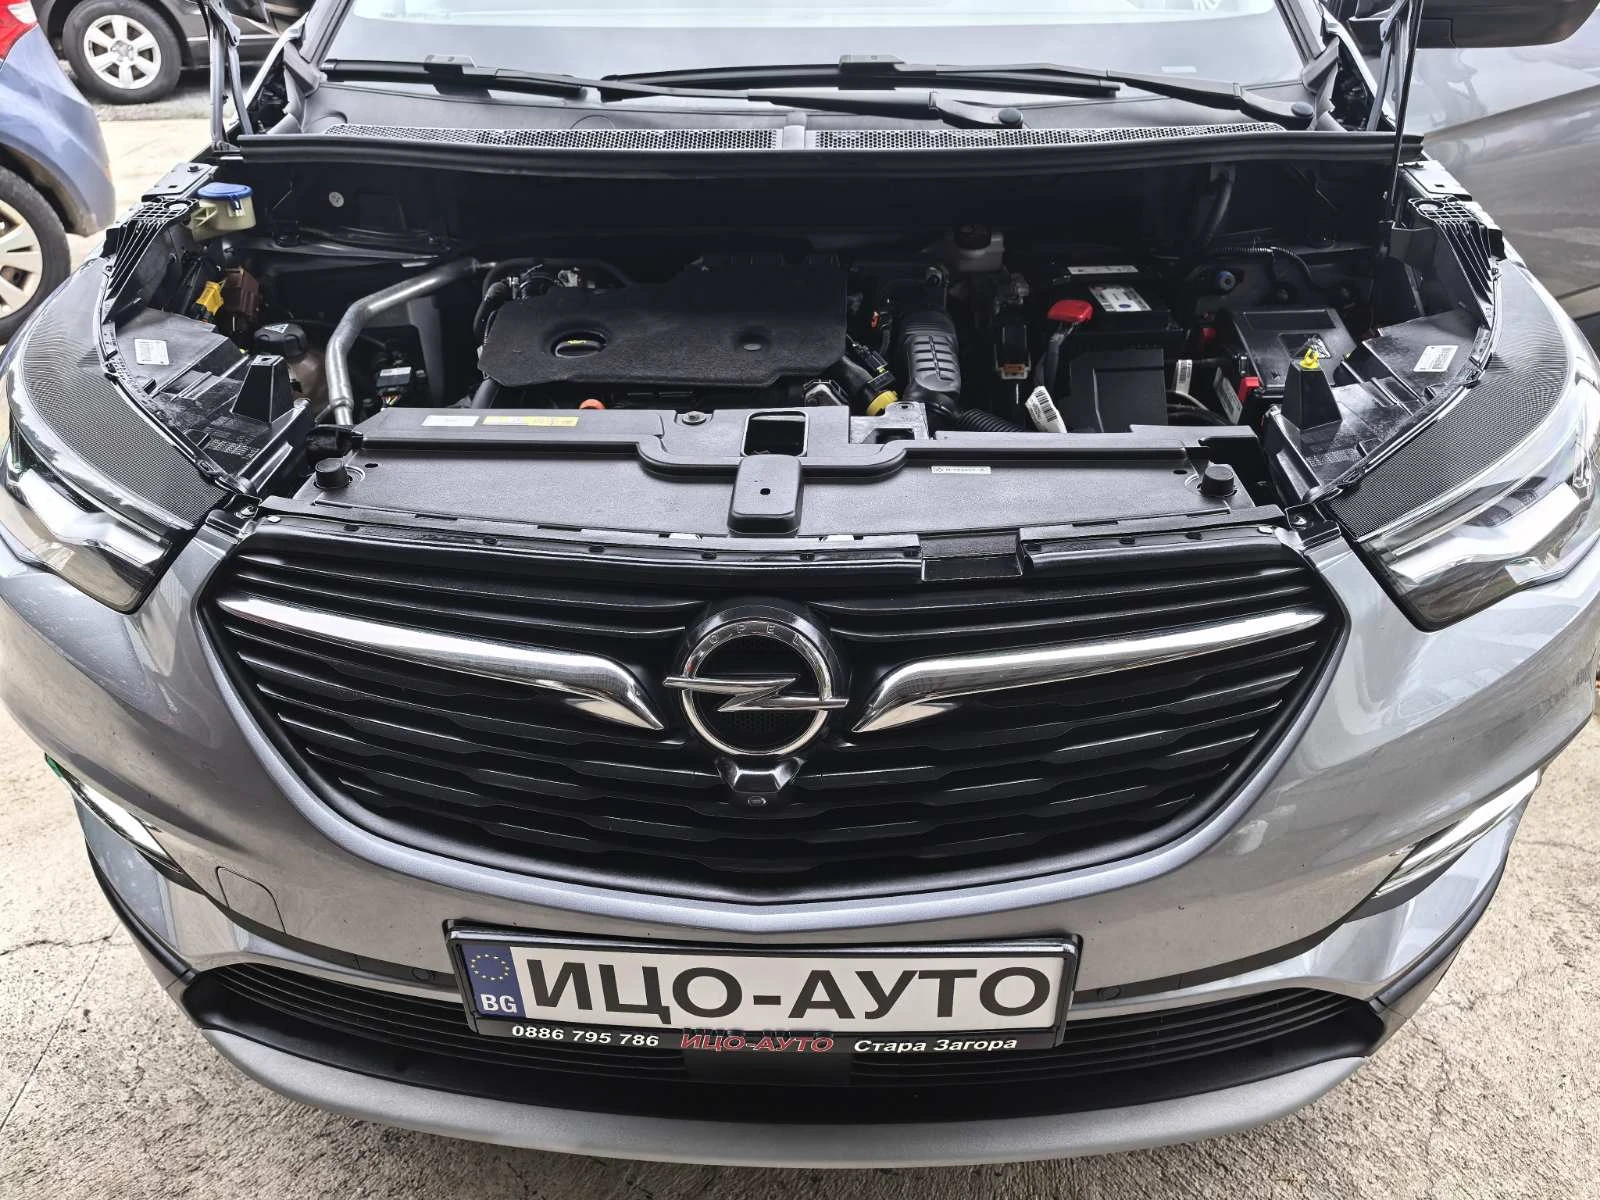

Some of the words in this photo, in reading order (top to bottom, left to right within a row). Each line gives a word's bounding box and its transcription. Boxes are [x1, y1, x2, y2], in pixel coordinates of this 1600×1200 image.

[708, 623, 802, 647] OPEL
[526, 958, 1051, 1024] ИЦО-АУТО
[480, 993, 518, 1013] BG
[512, 1024, 564, 1040] 0886
[572, 1030, 612, 1044] 795
[619, 1033, 659, 1047] 786
[680, 1033, 835, 1052] ИЦО-АУТО
[853, 1039, 927, 1053] Стара
[933, 1038, 1018, 1052] Загора
